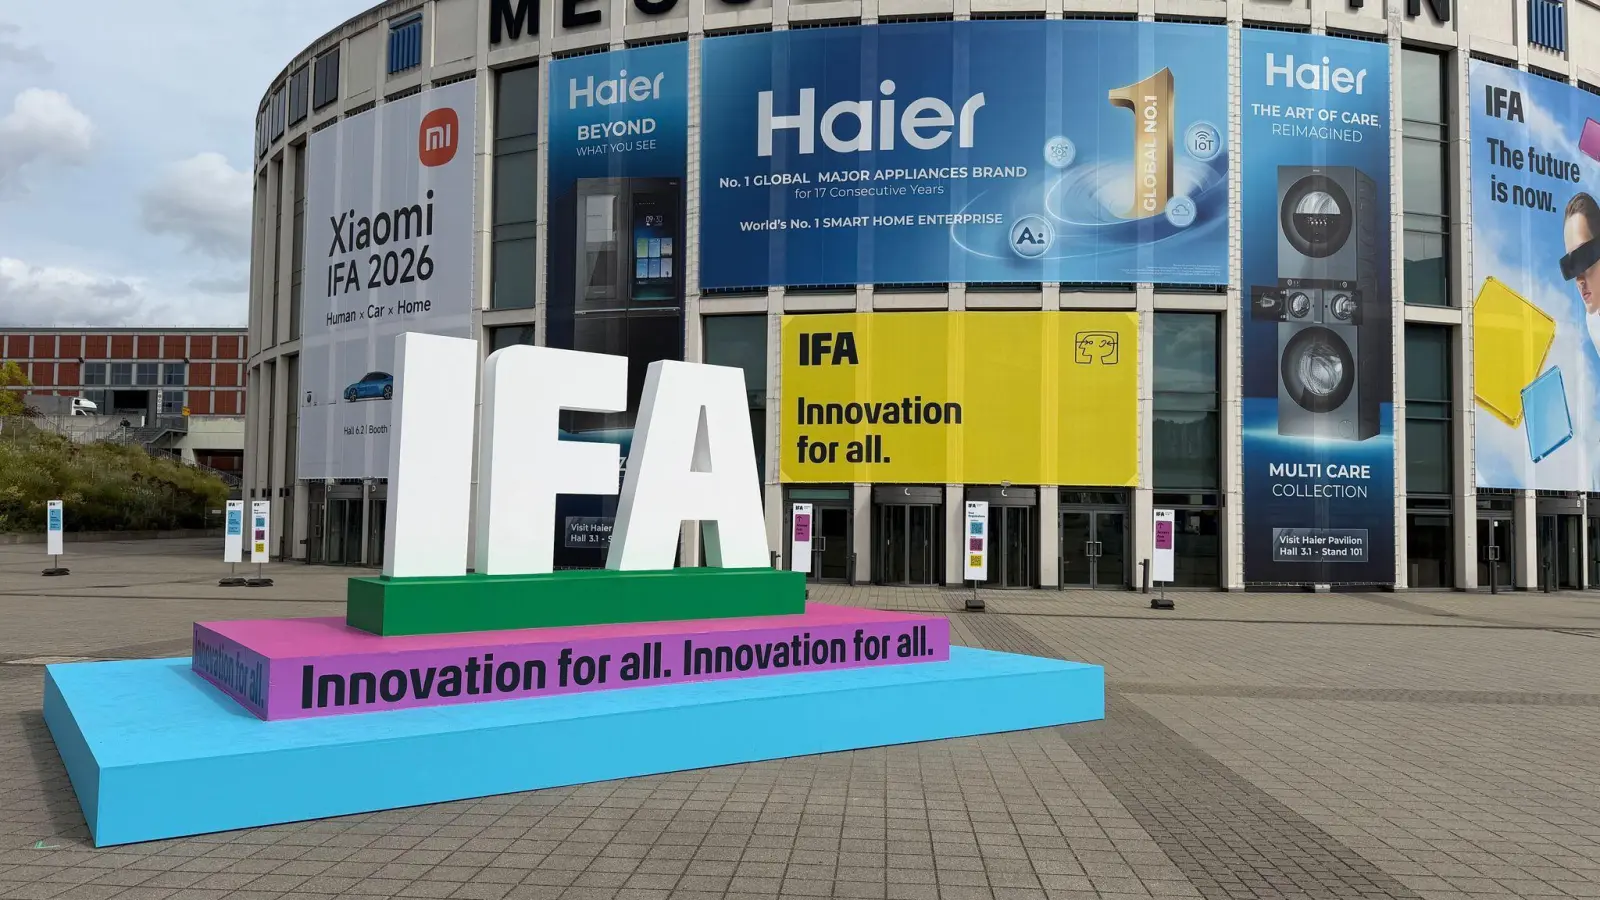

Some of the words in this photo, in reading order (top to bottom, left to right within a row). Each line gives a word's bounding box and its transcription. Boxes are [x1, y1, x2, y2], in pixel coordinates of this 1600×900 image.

[1266, 52, 1366, 94] Haier
[570, 69, 664, 110] Haier
[758, 79, 985, 156] Haier
[1144, 96, 1157, 133] NO.1
[1251, 104, 1280, 117] THE
[1285, 106, 1314, 120] ART
[1318, 109, 1337, 122] OF
[1486, 85, 1524, 123] IFA
[578, 118, 656, 141] BEYOND
[1273, 123, 1362, 142] REIMAGINED
[576, 145, 608, 157] WHAT
[610, 142, 632, 153] YOU
[636, 140, 656, 150] SEE
[1487, 137, 1524, 170] The
[1528, 146, 1580, 183] future
[720, 177, 741, 188] No.
[745, 176, 750, 186] 1
[754, 173, 810, 186] GLOBAL
[818, 170, 870, 183] MAJOR
[874, 167, 968, 181] APPLIANCES
[973, 166, 1027, 178] BRAND
[1144, 138, 1157, 211] GLOBAL
[795, 188, 812, 198] for
[814, 187, 826, 198] 17
[829, 185, 906, 198] Consecutive
[910, 184, 944, 196] Years
[1491, 174, 1508, 203] is
[1513, 185, 1556, 213] now.
[328, 190, 434, 257] Xiaomi
[740, 219, 787, 232] World's
[790, 219, 811, 230] No.
[814, 218, 820, 228] 1
[823, 216, 870, 228] SMART
[873, 215, 914, 226] HOME
[918, 213, 1003, 226] ENTERPRISE
[328, 259, 360, 297] IFA
[368, 245, 434, 289] 2026
[327, 309, 356, 326] Human
[367, 304, 385, 319] Car
[398, 300, 431, 314] Home
[800, 332, 859, 366] IFA
[797, 396, 962, 424] Innovation
[344, 426, 354, 435] Hall
[369, 424, 387, 434] Booth
[380, 332, 771, 578] IFA
[797, 436, 839, 463] for
[846, 434, 890, 463] all.
[1270, 463, 1321, 478] MULTI
[1326, 464, 1370, 479] CARE
[1273, 484, 1367, 498] COLLECTION
[591, 524, 612, 532] Haier
[1280, 536, 1300, 544] Visit
[1302, 536, 1326, 544] Haier
[1328, 536, 1362, 544] Pavilion
[1322, 548, 1347, 556] Stand
[195, 630, 233, 688] Innovation
[236, 652, 248, 696] for
[250, 661, 263, 708] all.
[301, 654, 546, 709] Innovation
[557, 648, 611, 687] for
[620, 642, 671, 681] all.
[683, 632, 845, 676] Innovation
[853, 629, 891, 661] for
[896, 625, 933, 658] all.
